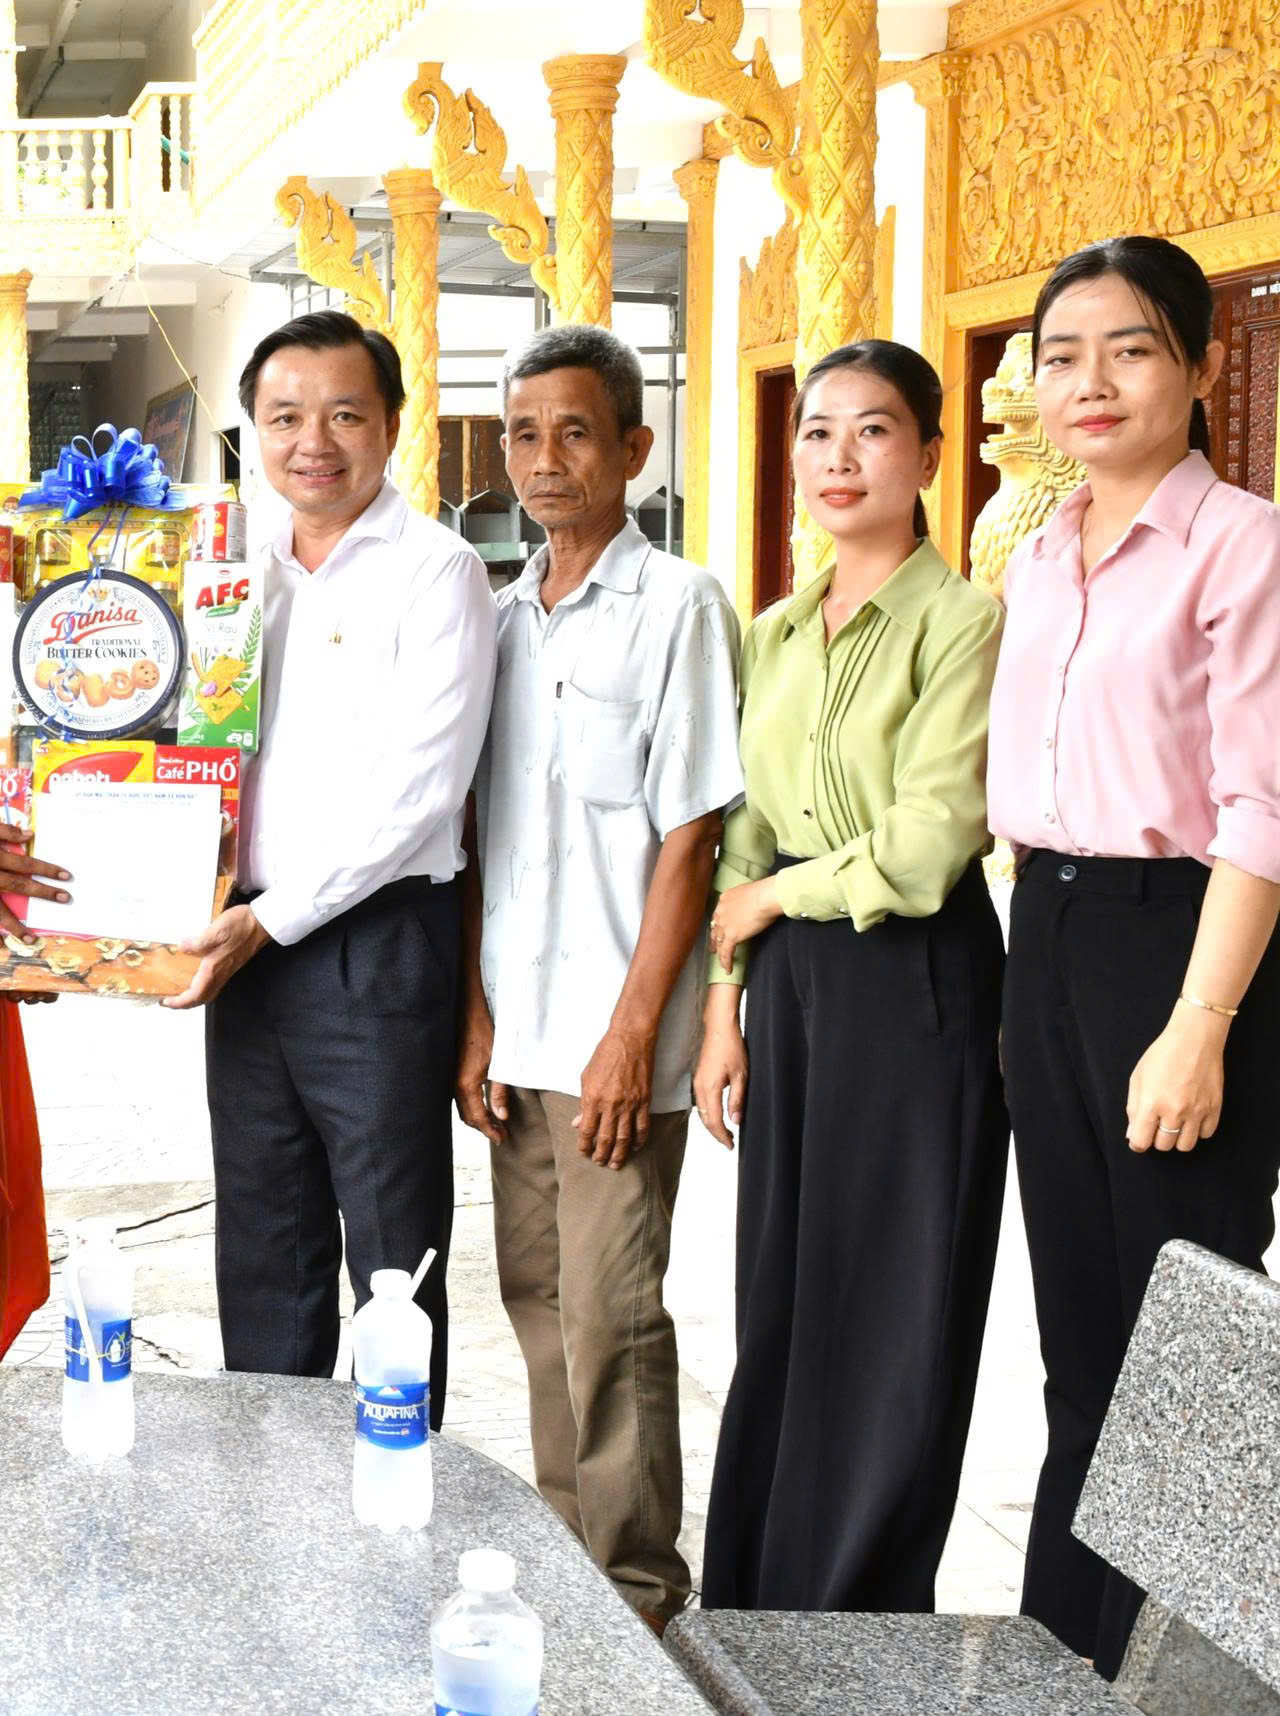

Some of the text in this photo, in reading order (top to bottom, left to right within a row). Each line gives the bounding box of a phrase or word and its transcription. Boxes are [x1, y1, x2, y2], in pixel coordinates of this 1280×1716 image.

[195, 578, 250, 610] AFC
[43, 601, 143, 645] Danisa
[91, 638, 142, 646] TRADITIONAL
[47, 647, 148, 660] BUTTER COOKIES
[156, 755, 237, 782] Café PHỐ
[363, 1404, 420, 1421] AQUAFINA
